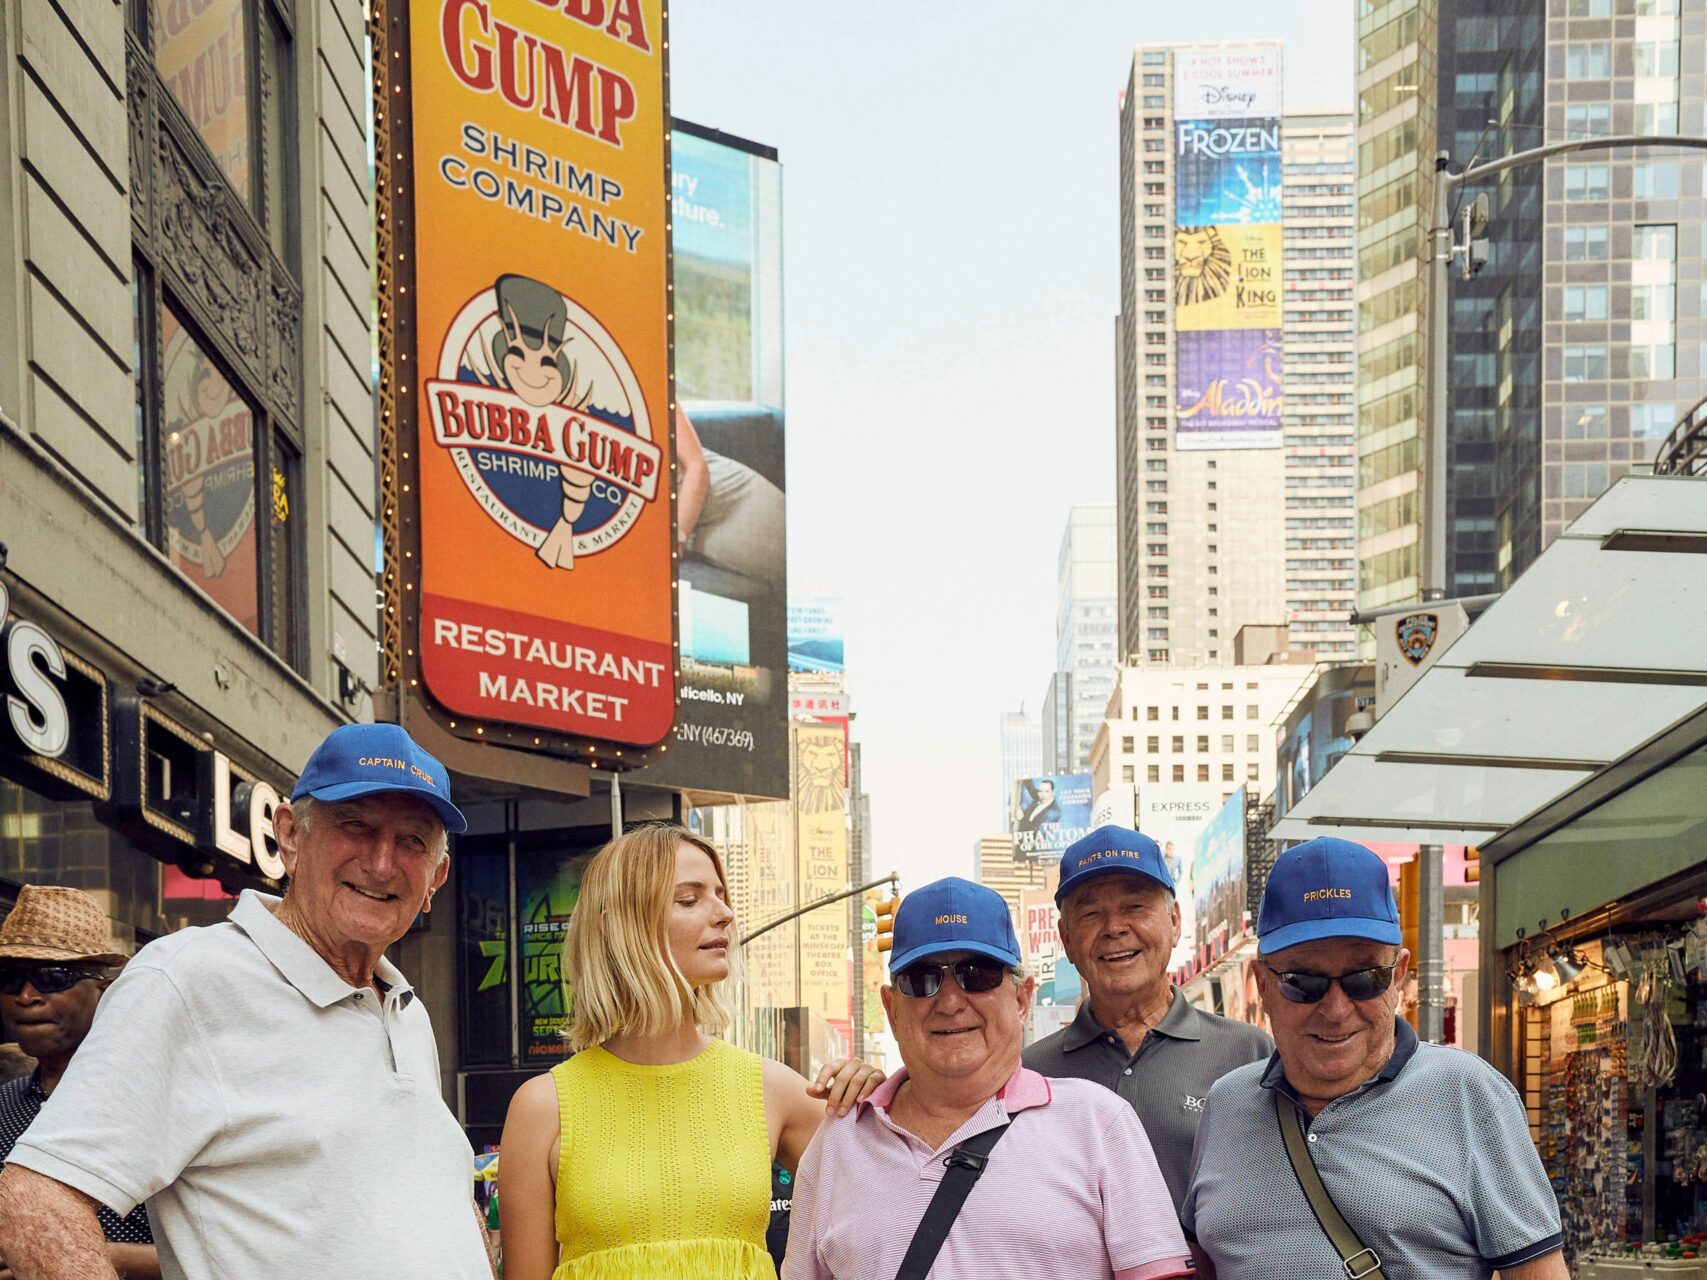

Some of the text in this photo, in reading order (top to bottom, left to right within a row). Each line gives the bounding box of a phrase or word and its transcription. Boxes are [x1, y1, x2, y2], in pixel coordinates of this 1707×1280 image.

[441, 0, 636, 147] GUMP
[1178, 123, 1280, 159] FROZEN
[462, 123, 623, 203] SHRIMP
[440, 157, 642, 252] COMPANY
[1242, 248, 1265, 259] THE
[1238, 263, 1272, 282] LION
[1236, 285, 1277, 308] KING
[435, 389, 656, 490] BUBBA GUMP
[477, 451, 560, 482] SHRIMP
[456, 450, 639, 550] RESTAURANT & MARKET
[434, 617, 666, 688] RESTAURANT
[478, 670, 629, 722] MARKET
[726, 691, 745, 706] NY
[358, 757, 436, 788] CAPTAIN CRUEL
[1151, 801, 1210, 812] EXPRESS
[809, 846, 833, 858] THE
[1079, 850, 1140, 868] PANTS ON FIRE
[806, 861, 838, 880] LION
[1303, 888, 1352, 903] PRICKLES
[523, 922, 561, 933] RISE
[808, 924, 839, 932] TICKETS
[935, 914, 968, 925] MOUSE
[802, 942, 845, 950] MINSKOFF
[807, 951, 841, 959] THEATRE
[810, 969, 837, 977] OFFICE
